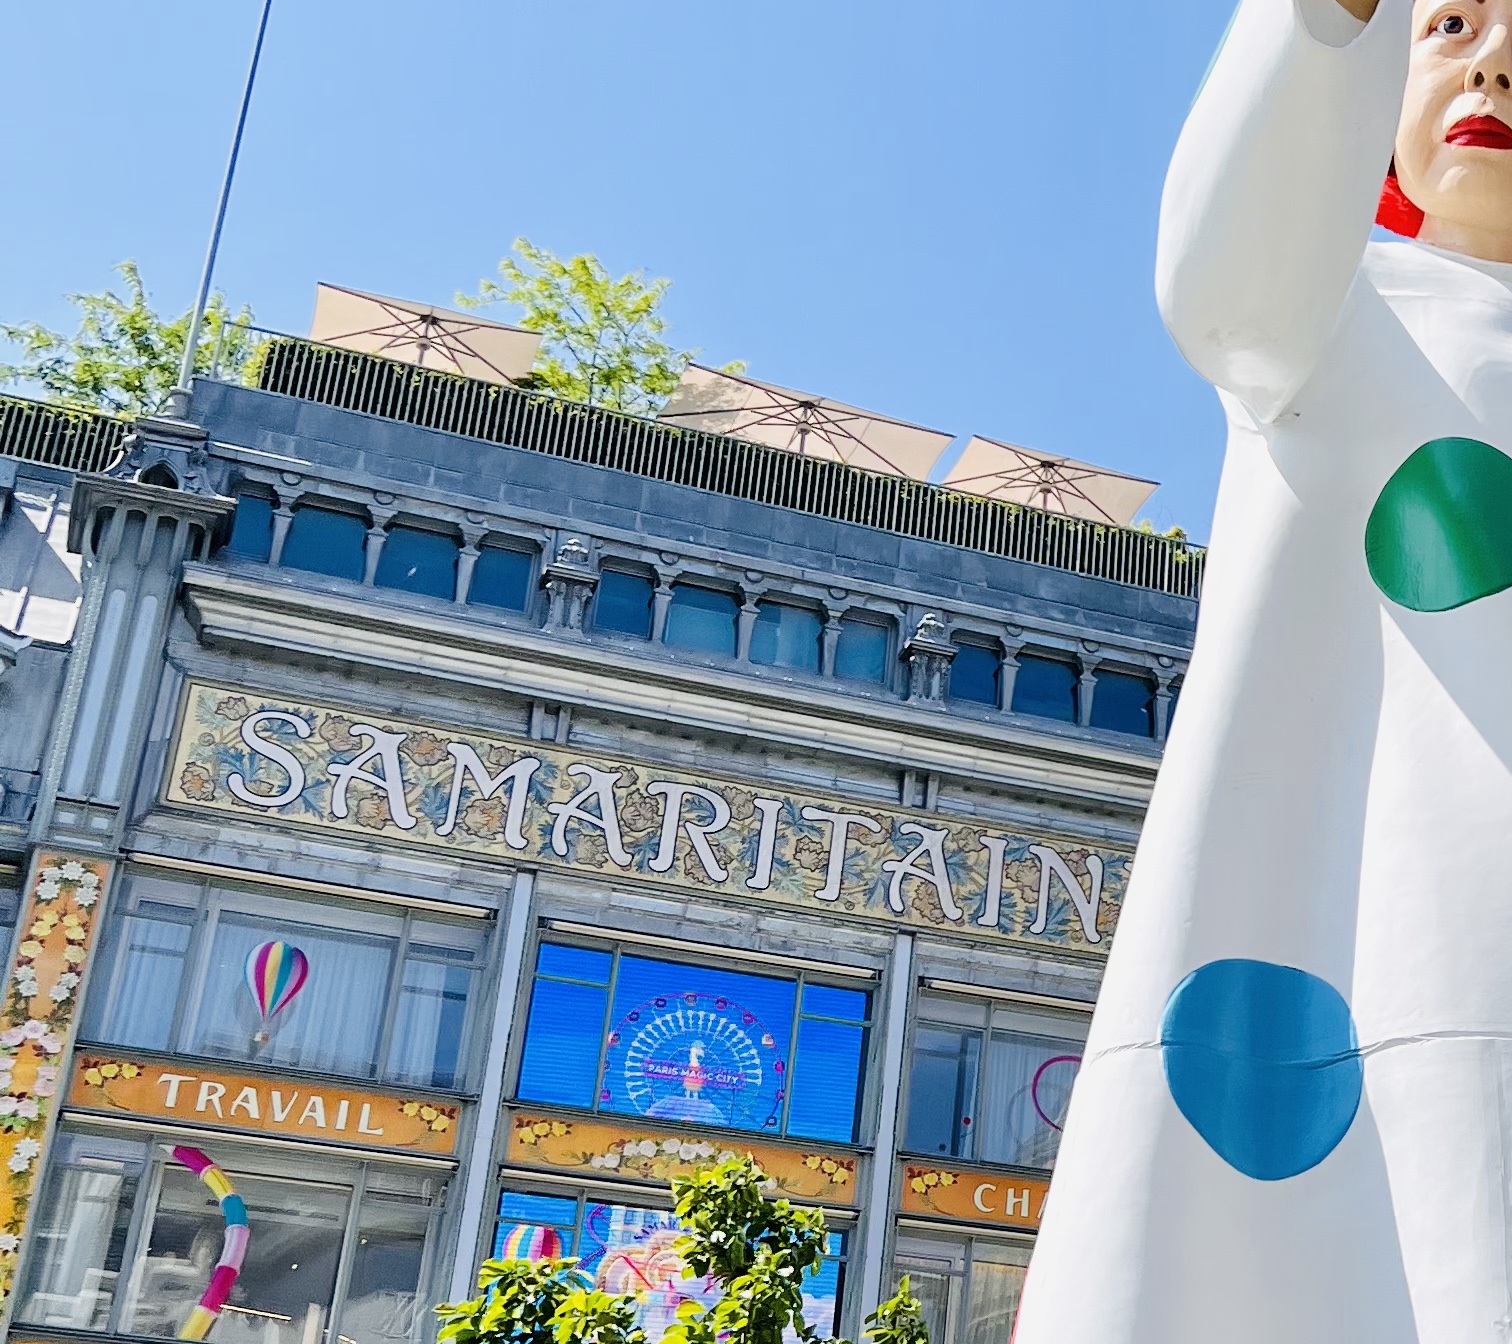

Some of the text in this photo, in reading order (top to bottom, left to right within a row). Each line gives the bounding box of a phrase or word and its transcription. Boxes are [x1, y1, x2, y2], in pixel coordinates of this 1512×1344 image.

[227, 710, 1133, 944] SAMARITAIN
[157, 1073, 384, 1136] TRAVAIL
[648, 1064, 739, 1084] PARIS MAGIC CITY
